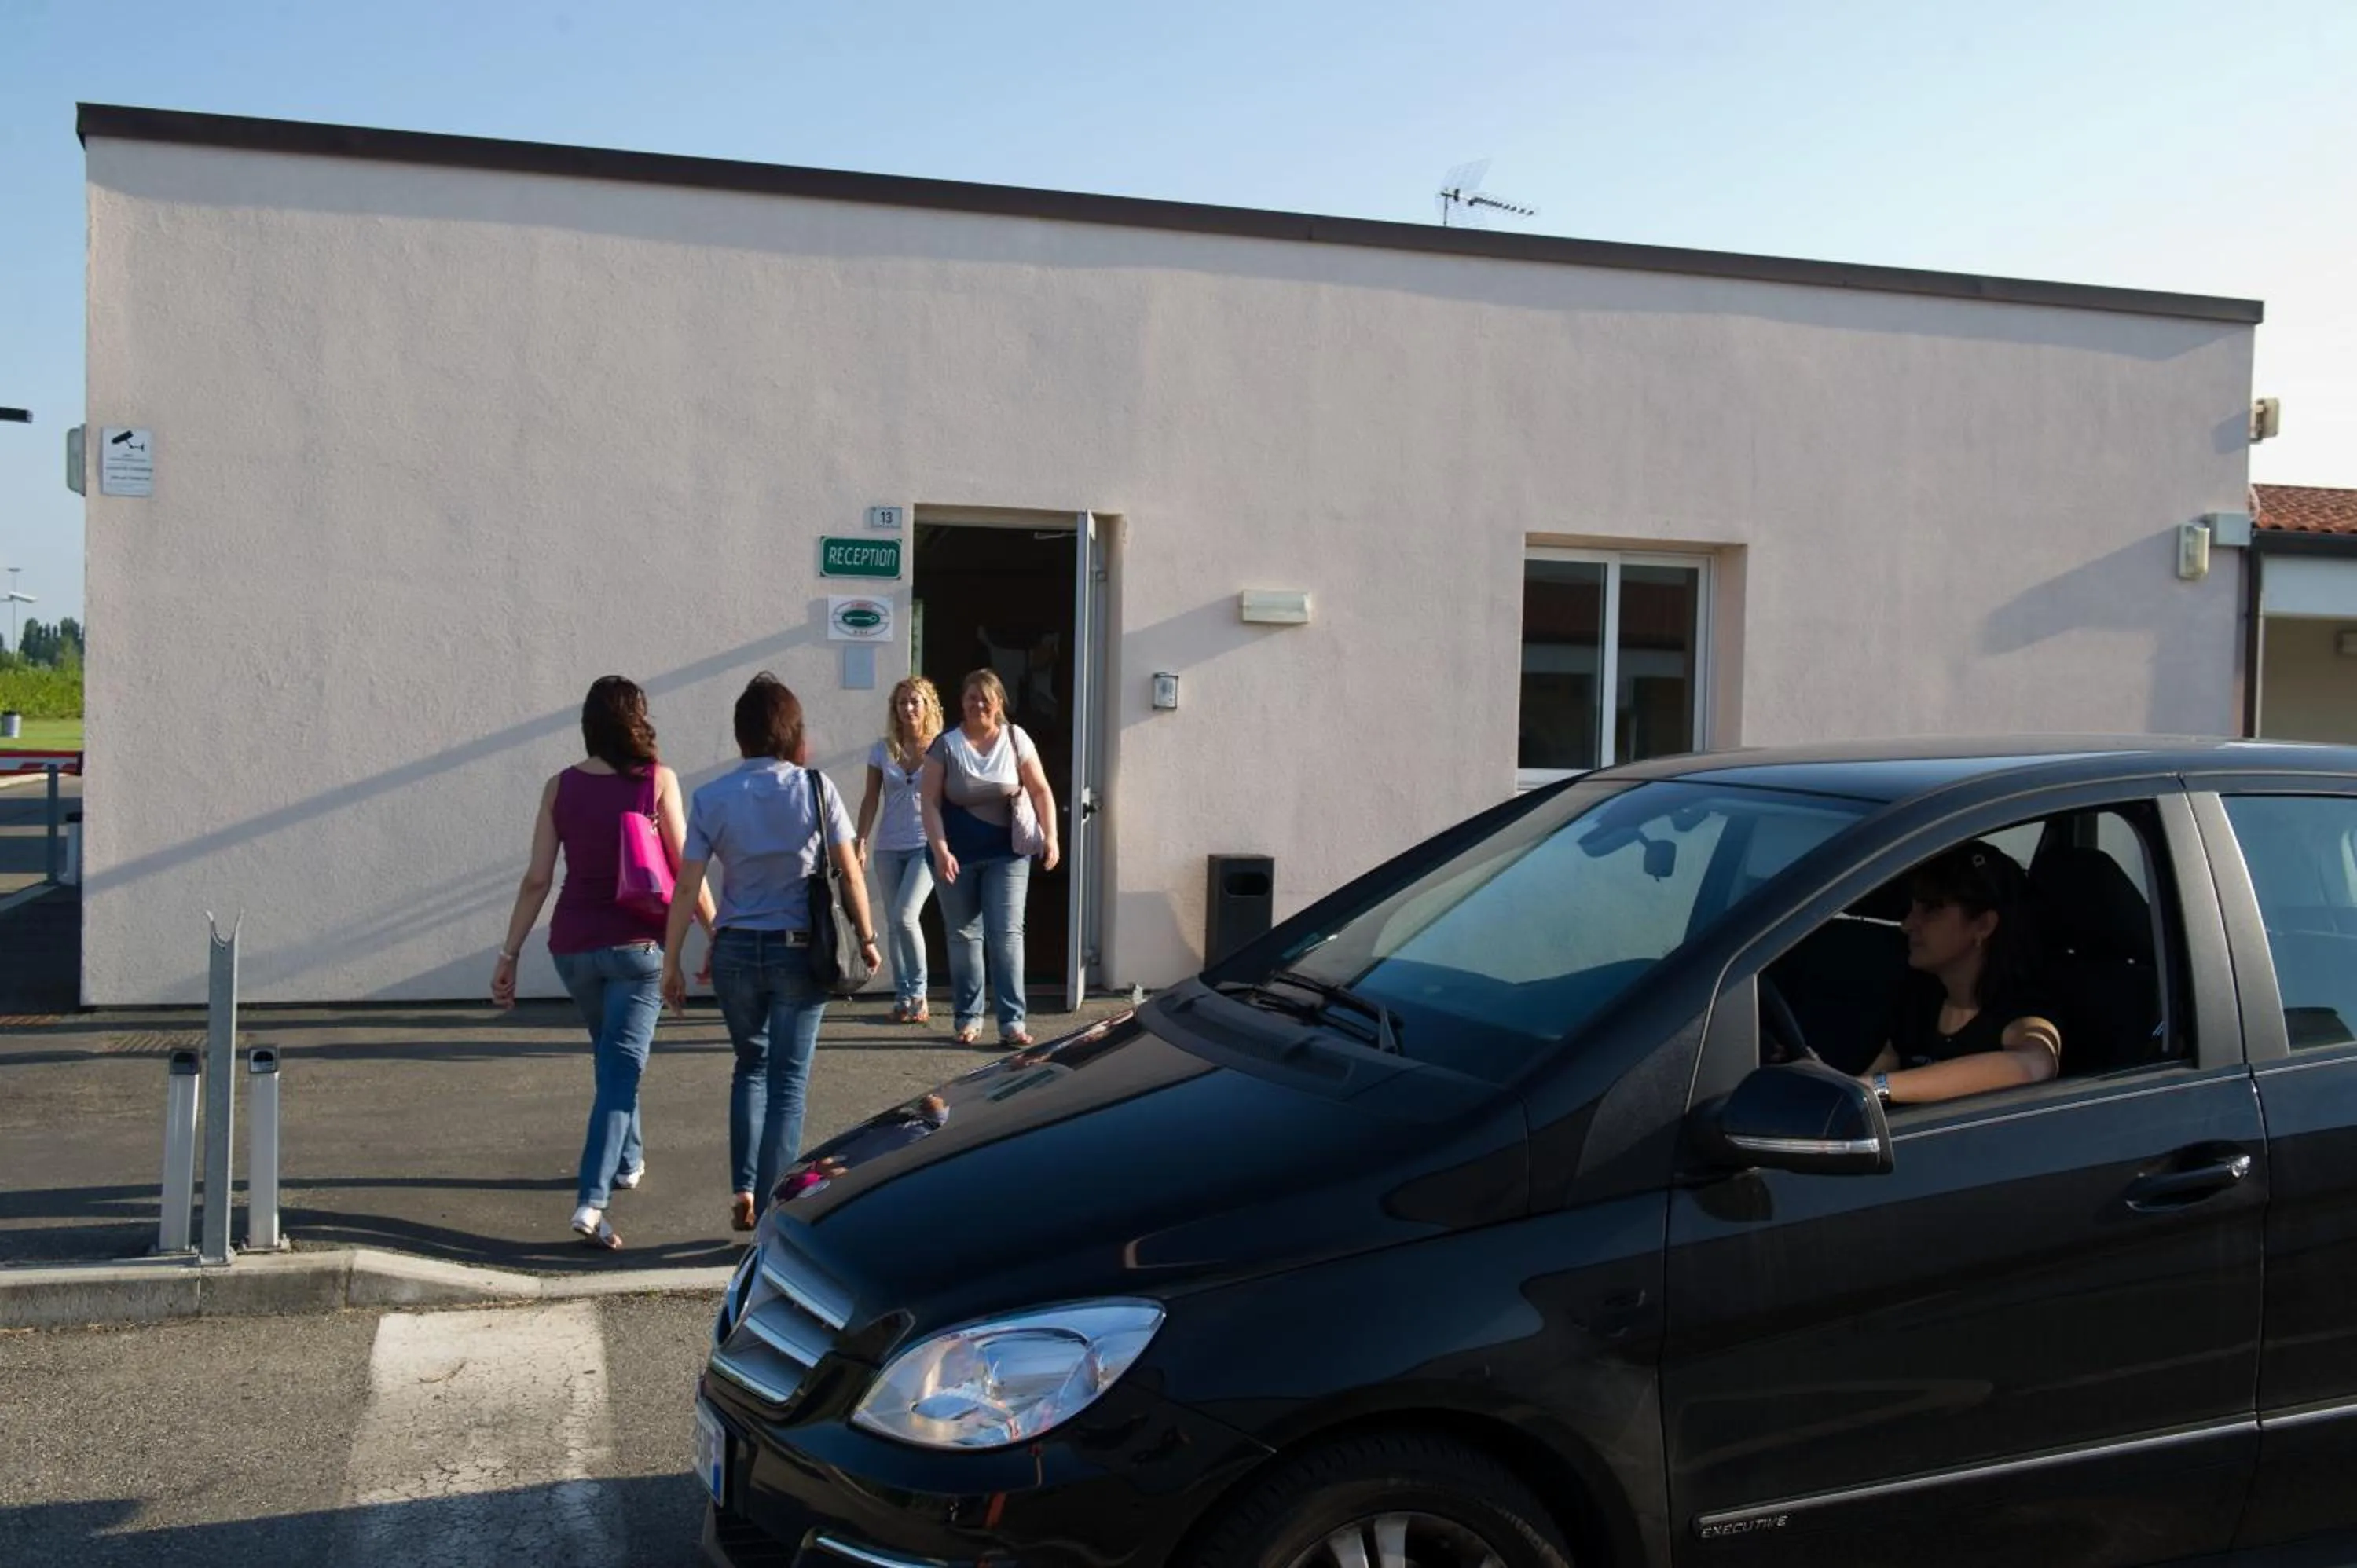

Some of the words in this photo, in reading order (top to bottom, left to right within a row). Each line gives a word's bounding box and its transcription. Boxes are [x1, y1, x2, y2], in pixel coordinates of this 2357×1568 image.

[880, 511, 893, 525] 13
[829, 546, 896, 566] RECEPTION
[1701, 1515, 1788, 1539] EXECUTIVE
